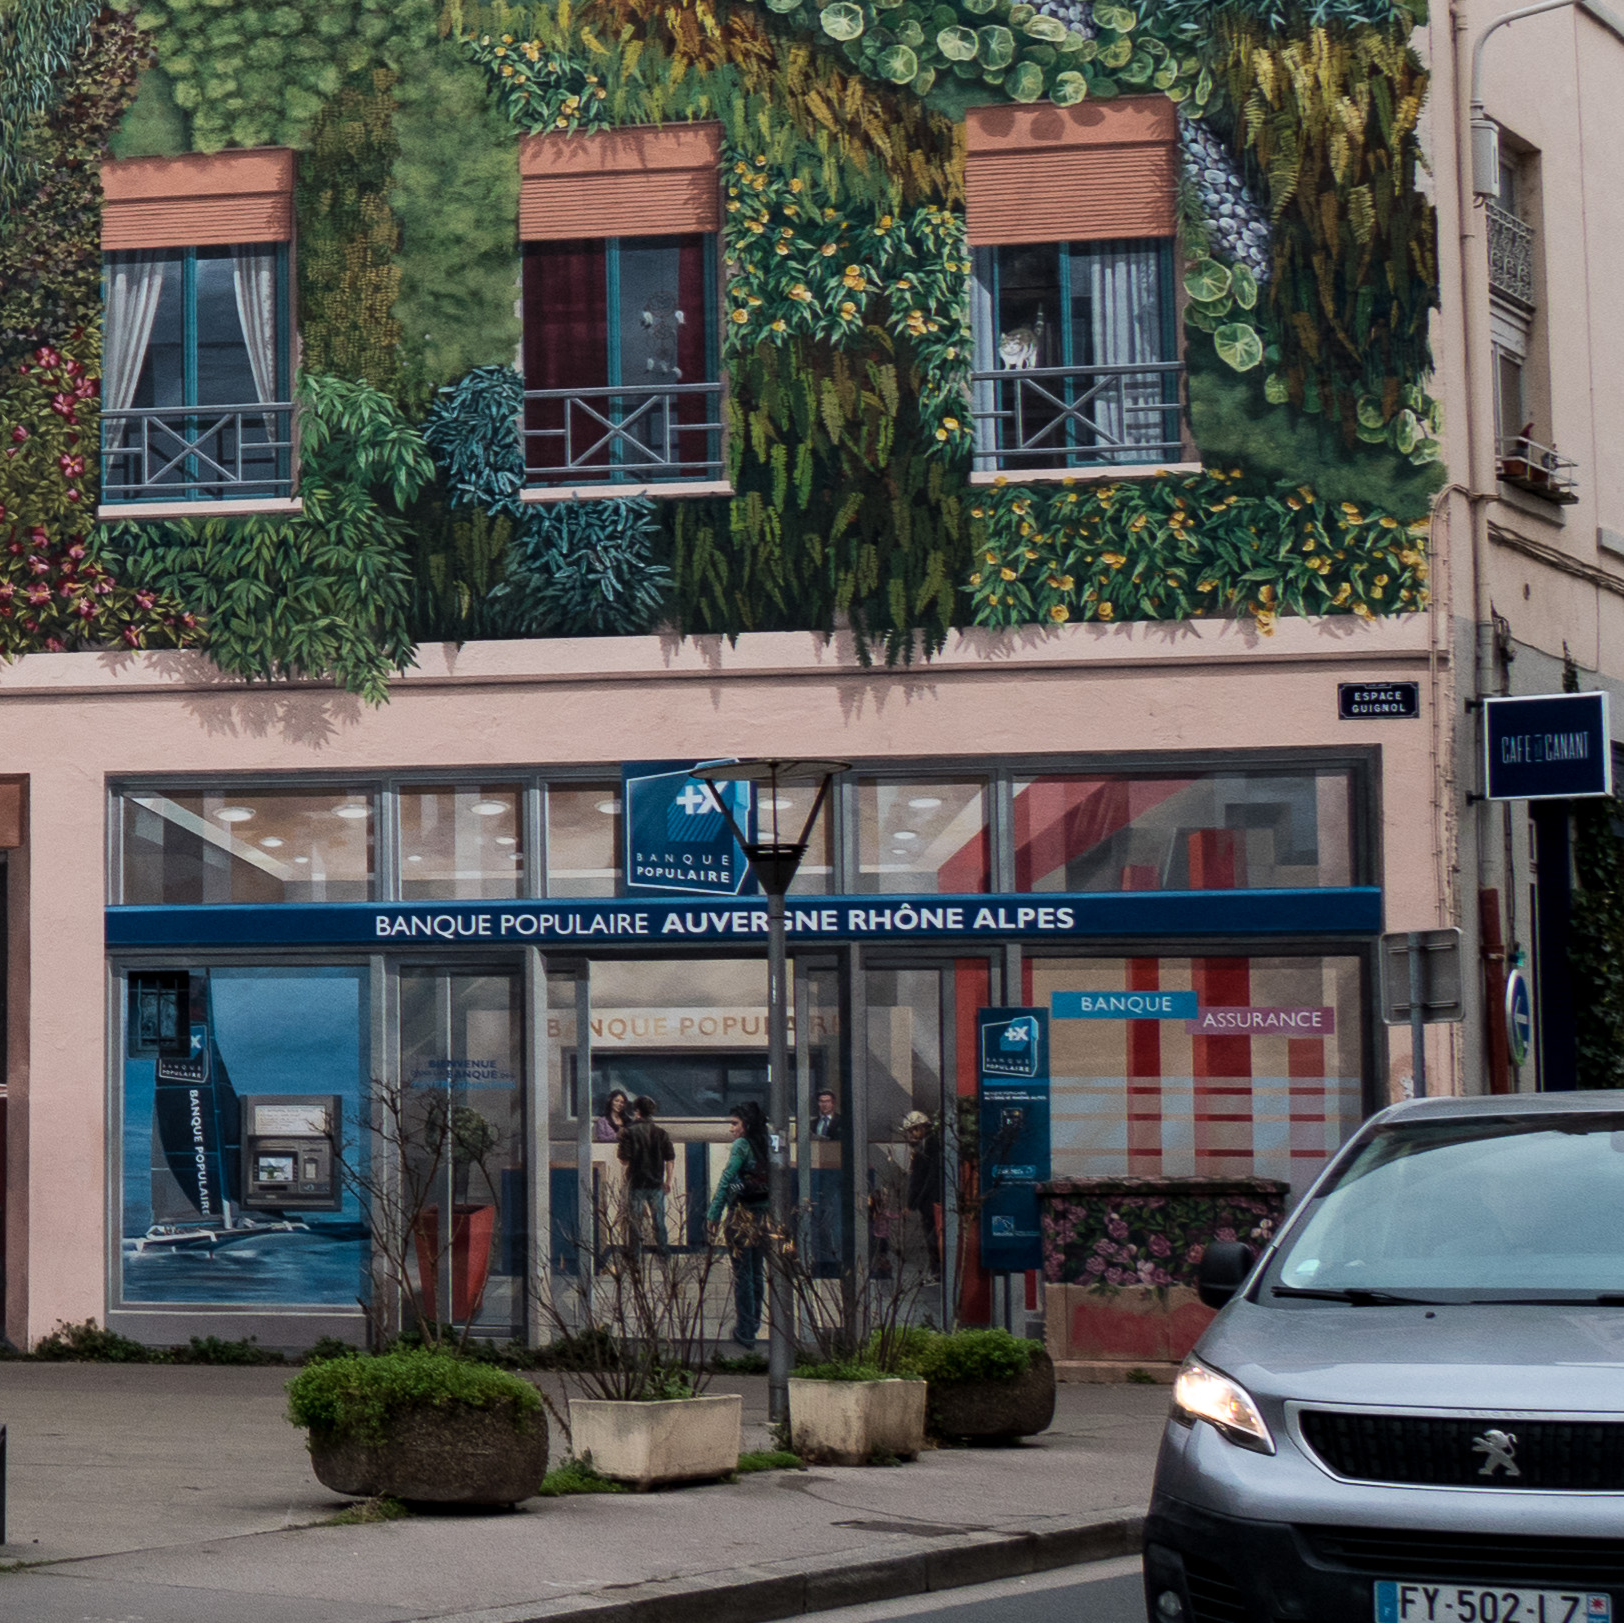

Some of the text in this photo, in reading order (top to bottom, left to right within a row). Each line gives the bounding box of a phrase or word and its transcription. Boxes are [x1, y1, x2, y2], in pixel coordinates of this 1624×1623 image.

[1354, 690, 1402, 702] ESPACE
[1351, 702, 1407, 714] GUIGNOL
[636, 852, 731, 867] BANQUE
[636, 865, 731, 884] POPULAIRE
[375, 914, 492, 939] BANQUE
[500, 912, 648, 936] POPULAIRE
[848, 902, 965, 931] RHÔNE
[973, 906, 1076, 930] ALPES
[1080, 996, 1172, 1013] BANQUE
[1202, 1011, 1322, 1028] ASSURANCE
[188, 1088, 211, 1215] BANQUE POPULAIRE
